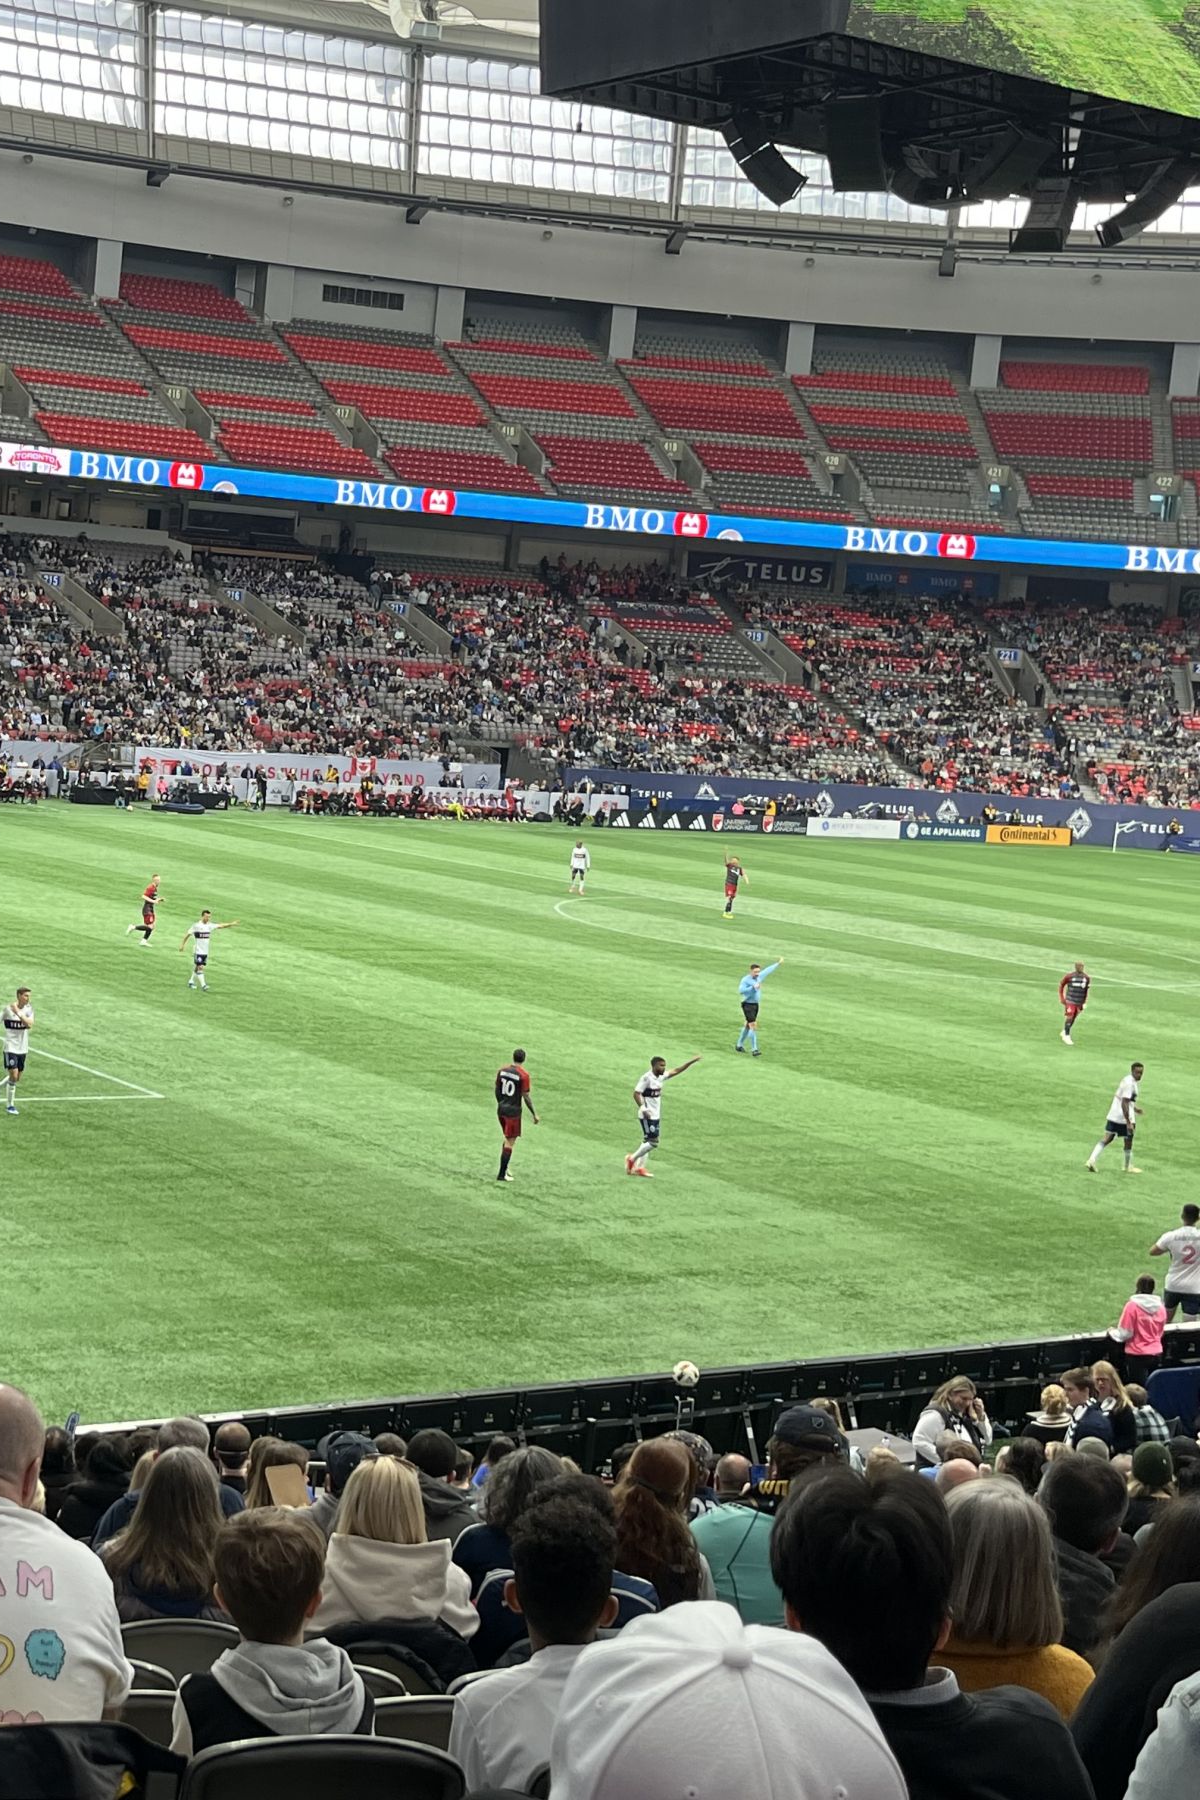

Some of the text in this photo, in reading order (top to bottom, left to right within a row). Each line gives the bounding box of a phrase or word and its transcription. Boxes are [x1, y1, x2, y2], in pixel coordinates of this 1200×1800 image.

[80, 452, 160, 484] BMO
[988, 468, 1001, 477] 421
[1156, 477, 1172, 487] 422
[334, 480, 413, 511] BMO
[584, 505, 664, 533] BMO
[843, 527, 928, 555] BMO
[744, 562, 824, 583] TELUS
[866, 573, 893, 583] BMO
[930, 577, 957, 588] BMO
[999, 650, 1015, 660] 221
[933, 827, 980, 838] APPLIANCES
[1000, 827, 1050, 842] Continental
[501, 1078, 515, 1097] 10
